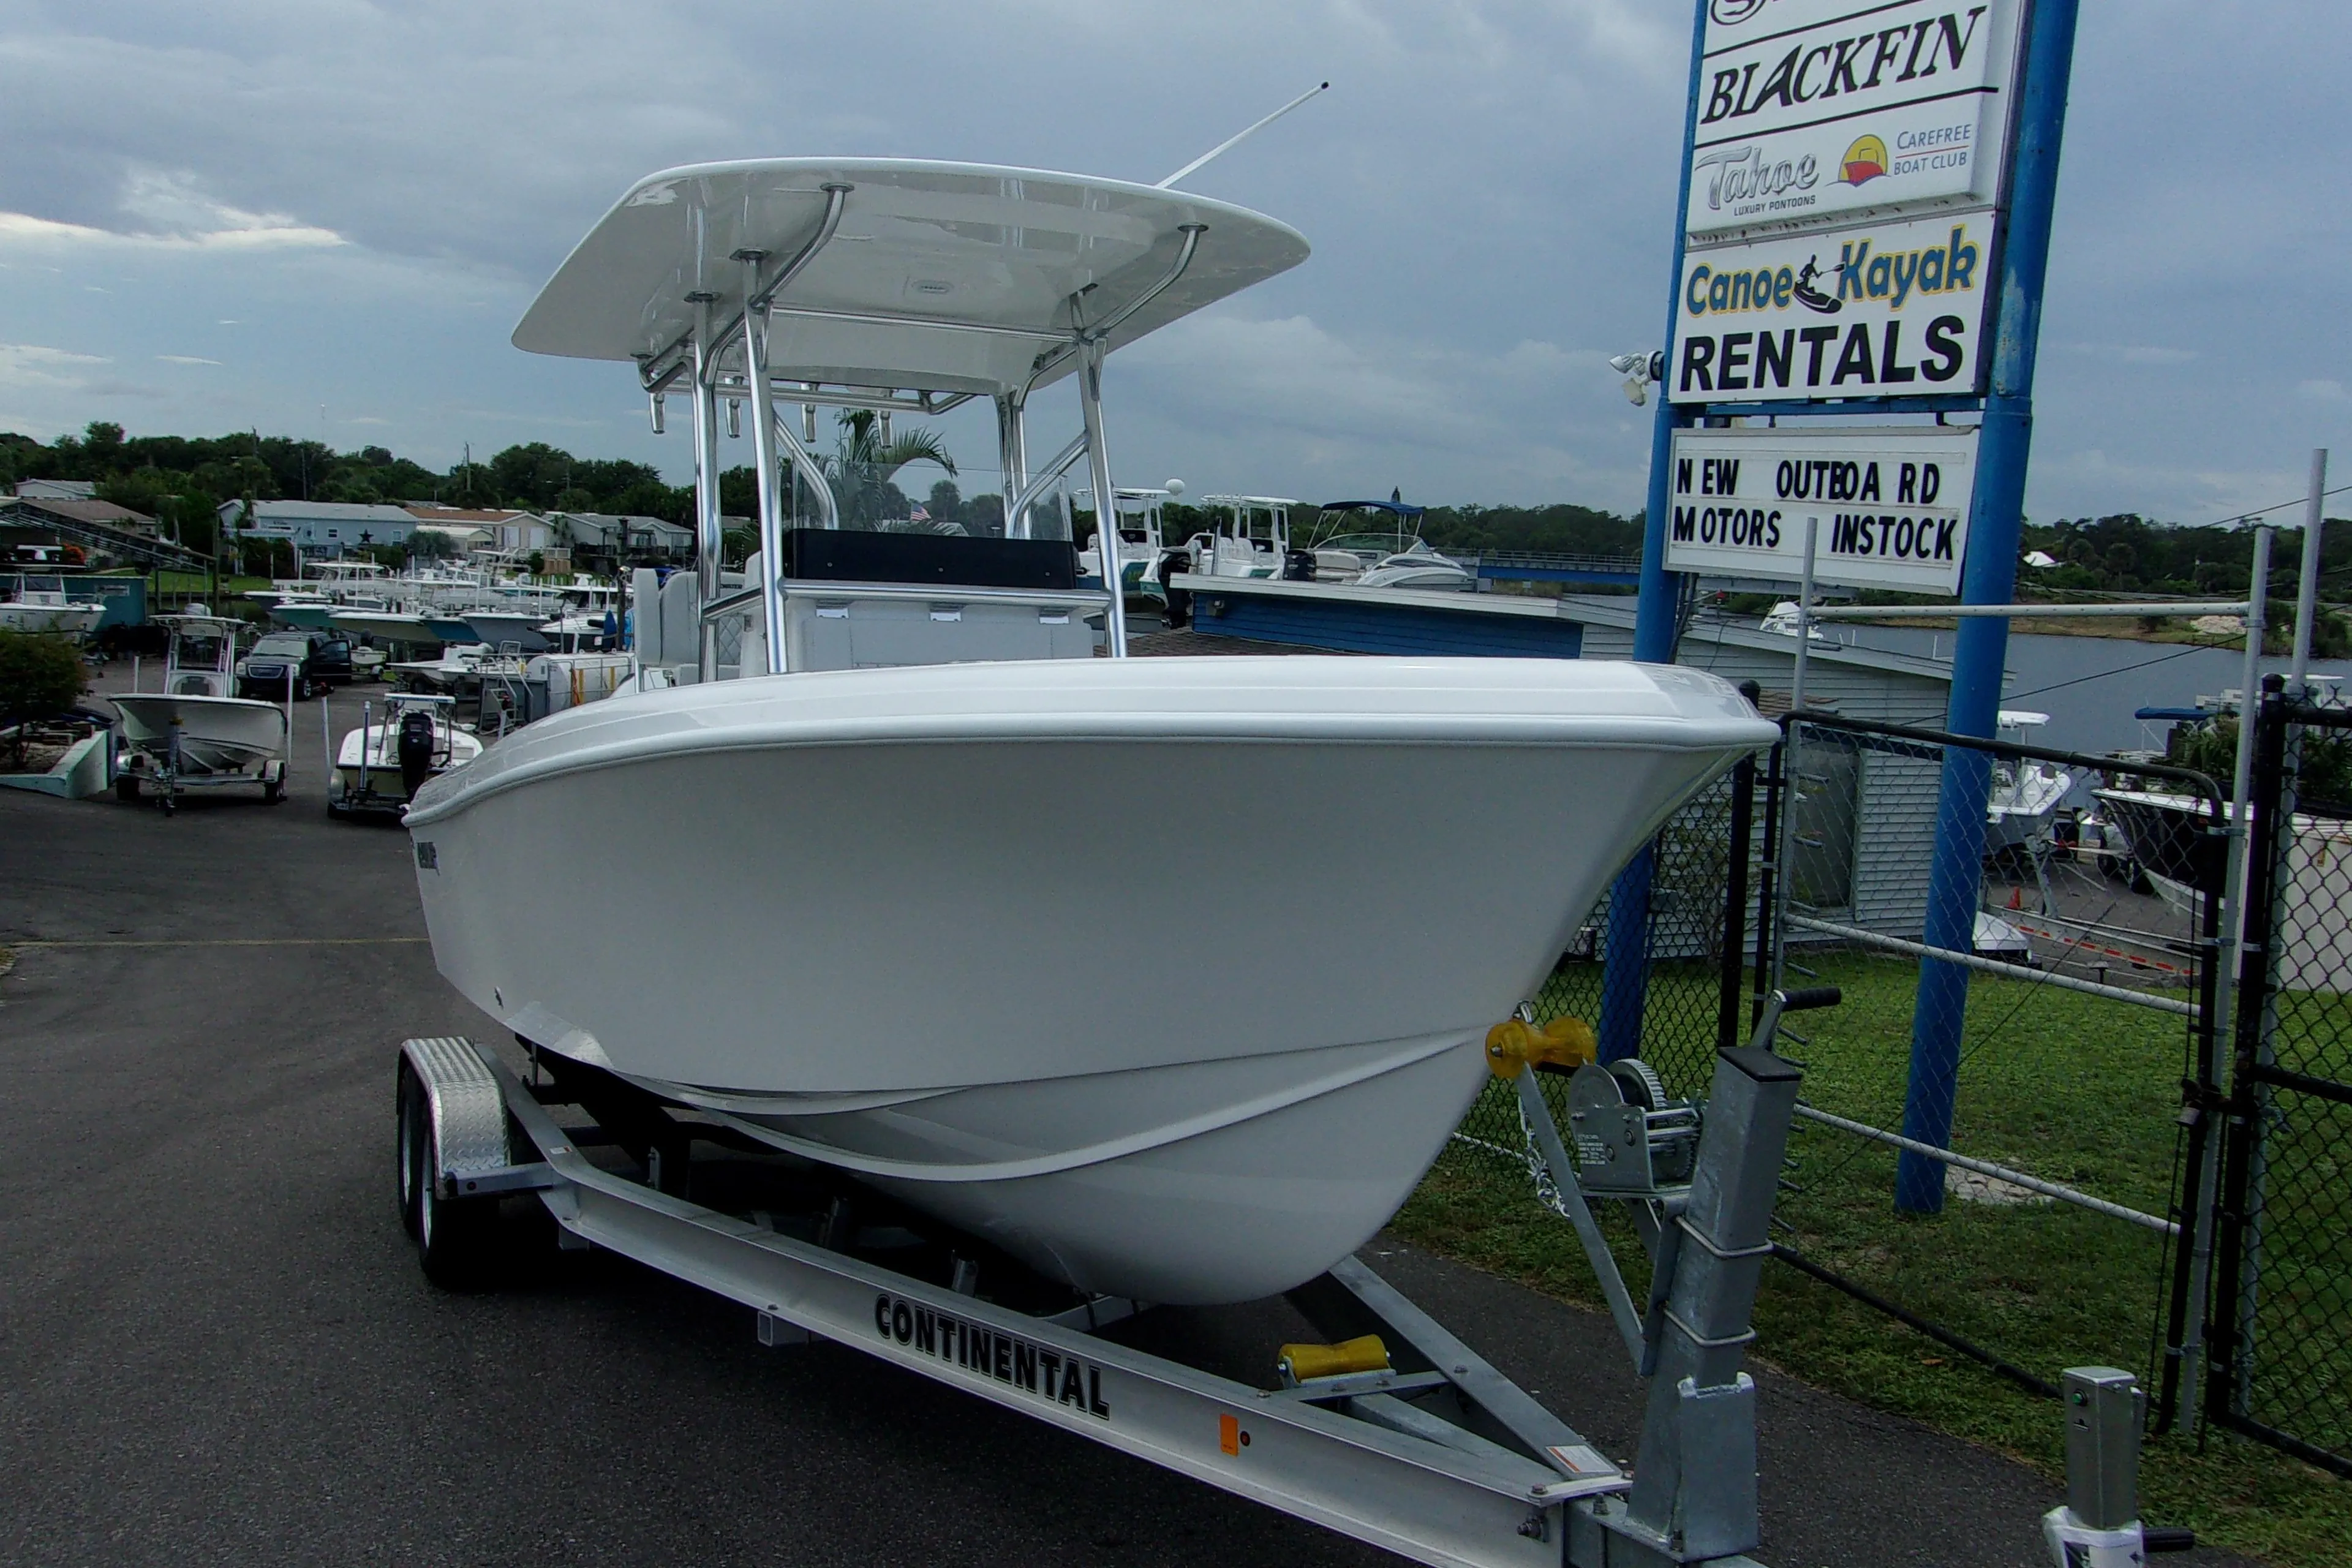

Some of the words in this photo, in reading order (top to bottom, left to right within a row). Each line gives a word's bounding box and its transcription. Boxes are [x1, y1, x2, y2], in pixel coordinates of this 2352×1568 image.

[1700, 5, 1987, 124] BLACKFIN
[1894, 154, 1929, 175] BOAT
[1932, 151, 1967, 170] CLUB
[1897, 124, 1972, 149] CAREFREE
[1694, 145, 1820, 209] Tahoe
[1733, 204, 1766, 216] LUXURY
[1769, 195, 1816, 210] PONTOONS
[1686, 262, 1793, 317] Canoe
[1838, 223, 1979, 312] Kayak
[1679, 315, 1965, 393] RENTALS
[1673, 506, 1782, 548] MOTORS
[1831, 514, 1958, 560] INSTOCK
[875, 1294, 1110, 1420] CONTINENTAL
